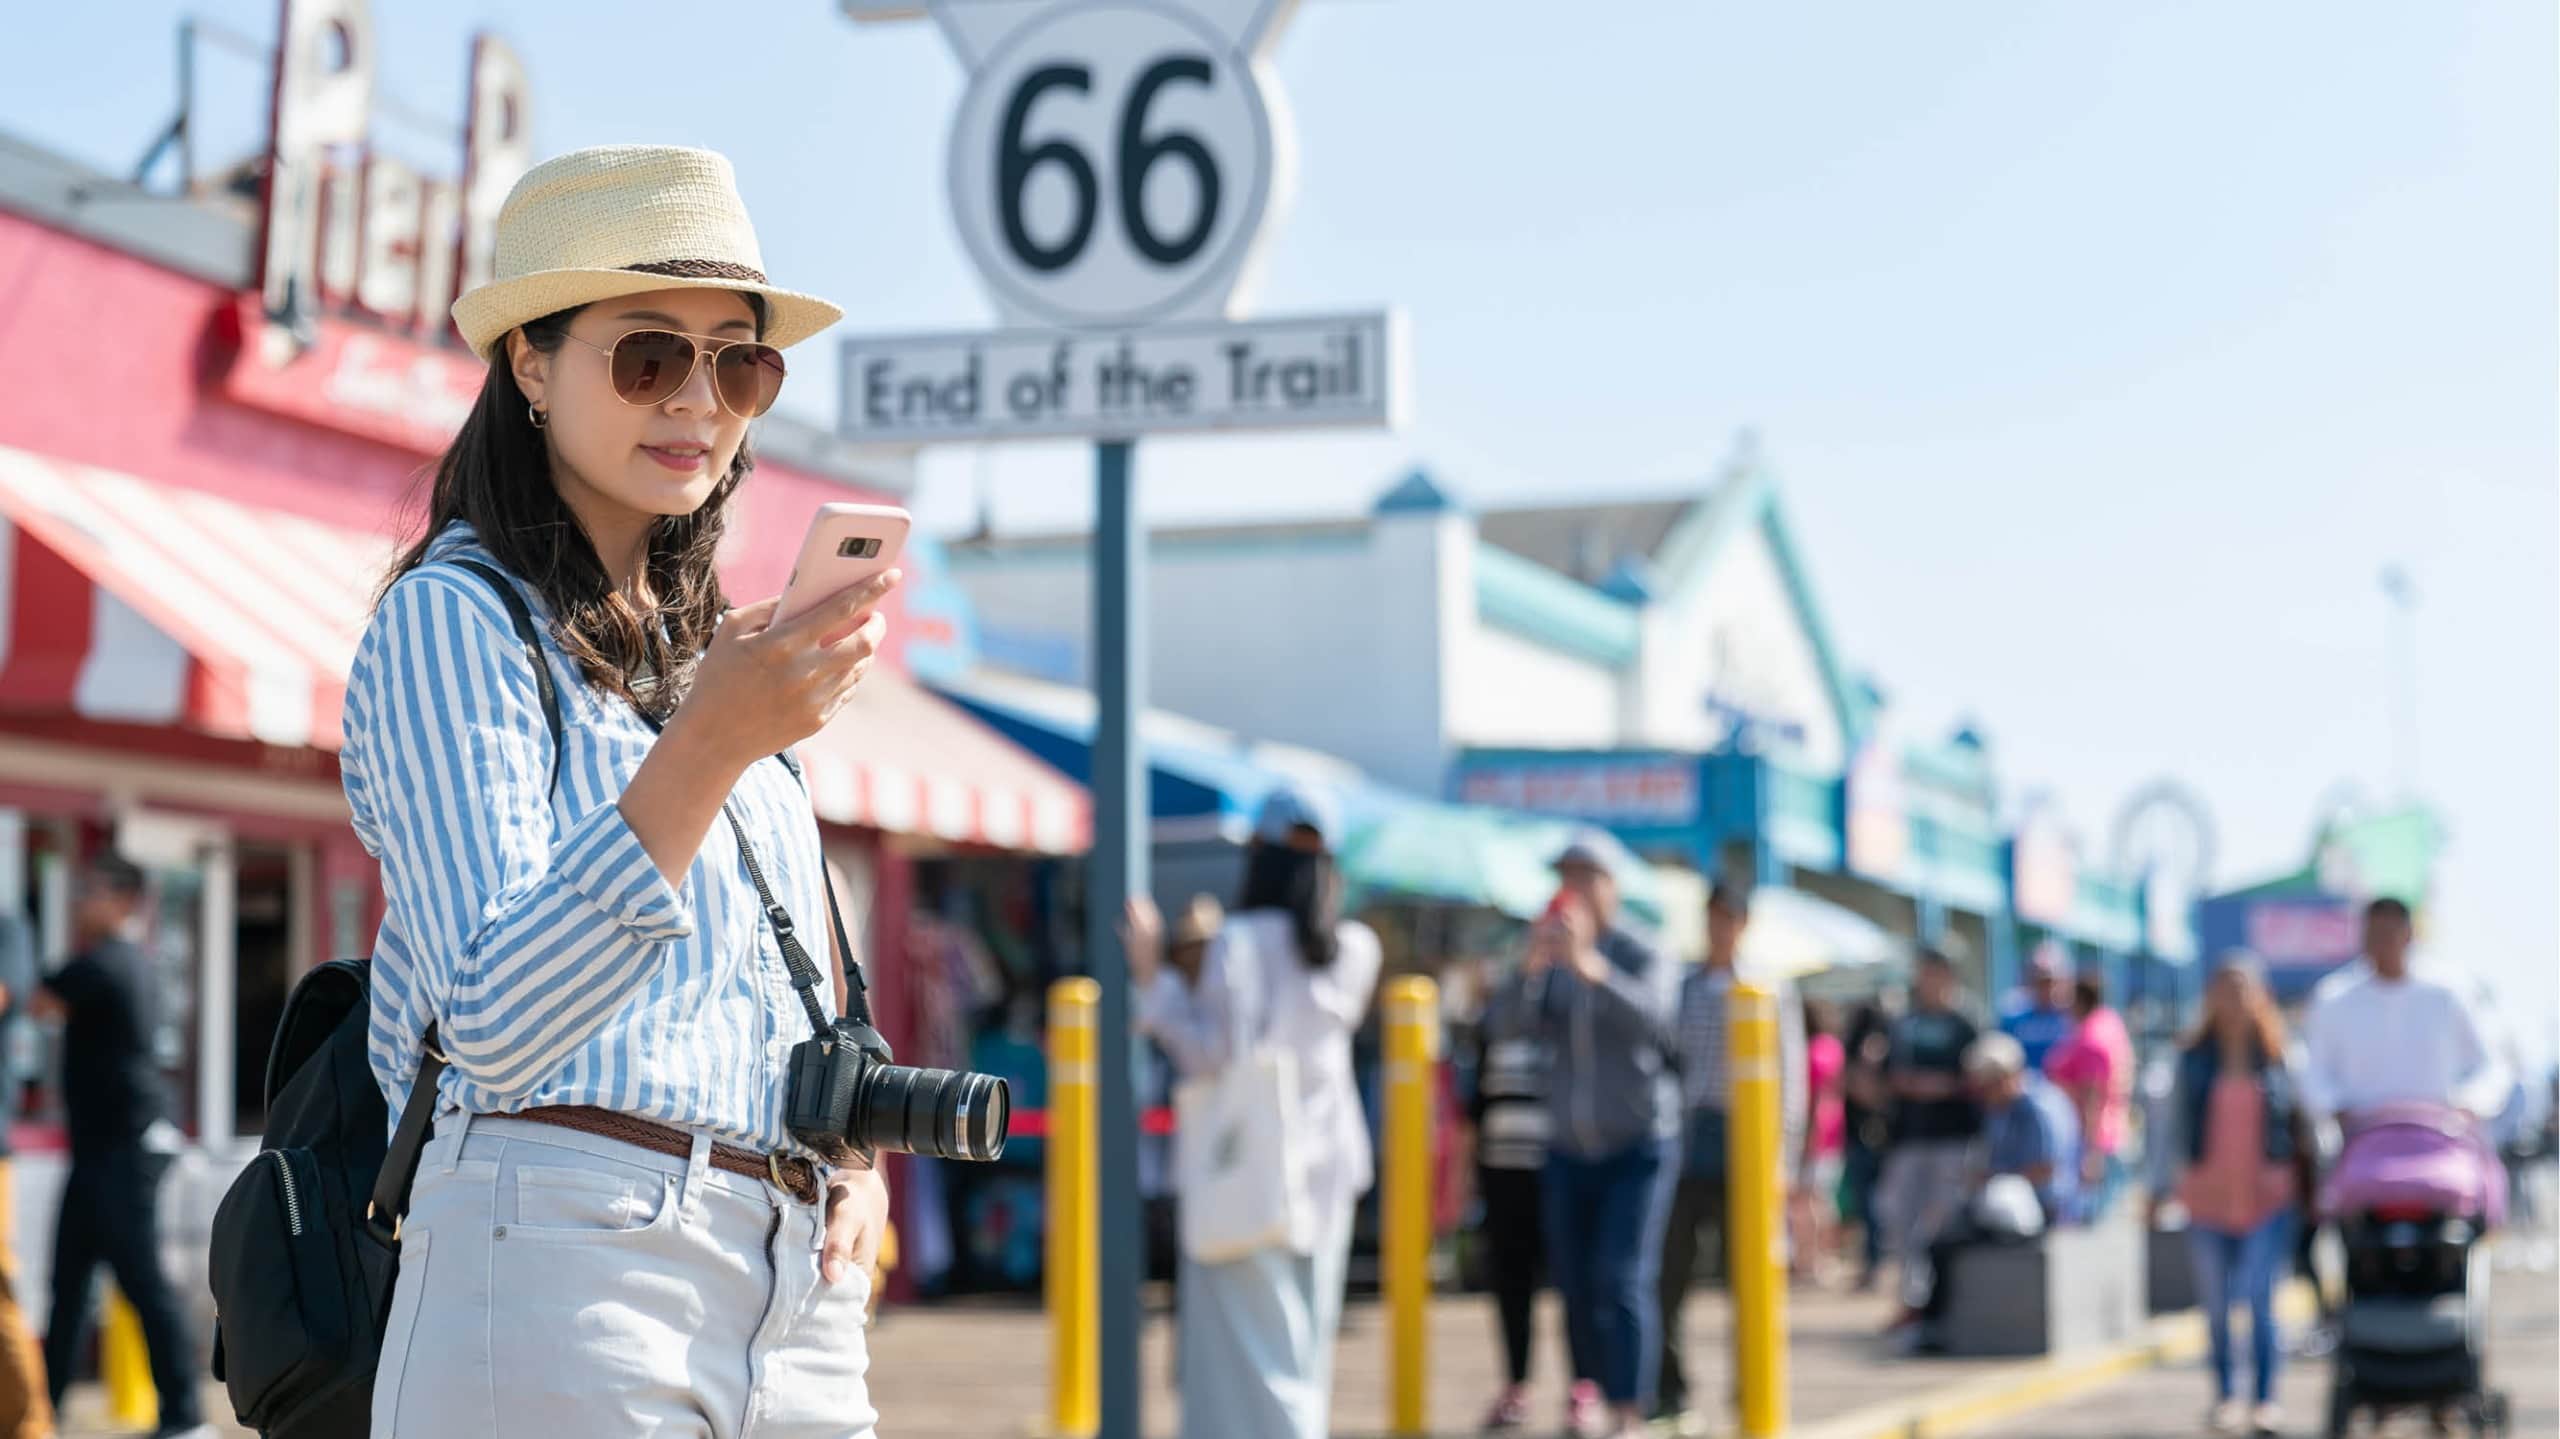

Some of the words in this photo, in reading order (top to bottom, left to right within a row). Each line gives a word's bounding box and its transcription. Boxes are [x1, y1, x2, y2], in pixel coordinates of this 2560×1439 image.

[997, 56, 1221, 271] 66
[865, 346, 981, 426] End
[1007, 339, 1070, 418] of
[1097, 338, 1194, 412] the
[1219, 332, 1360, 407] Trail
